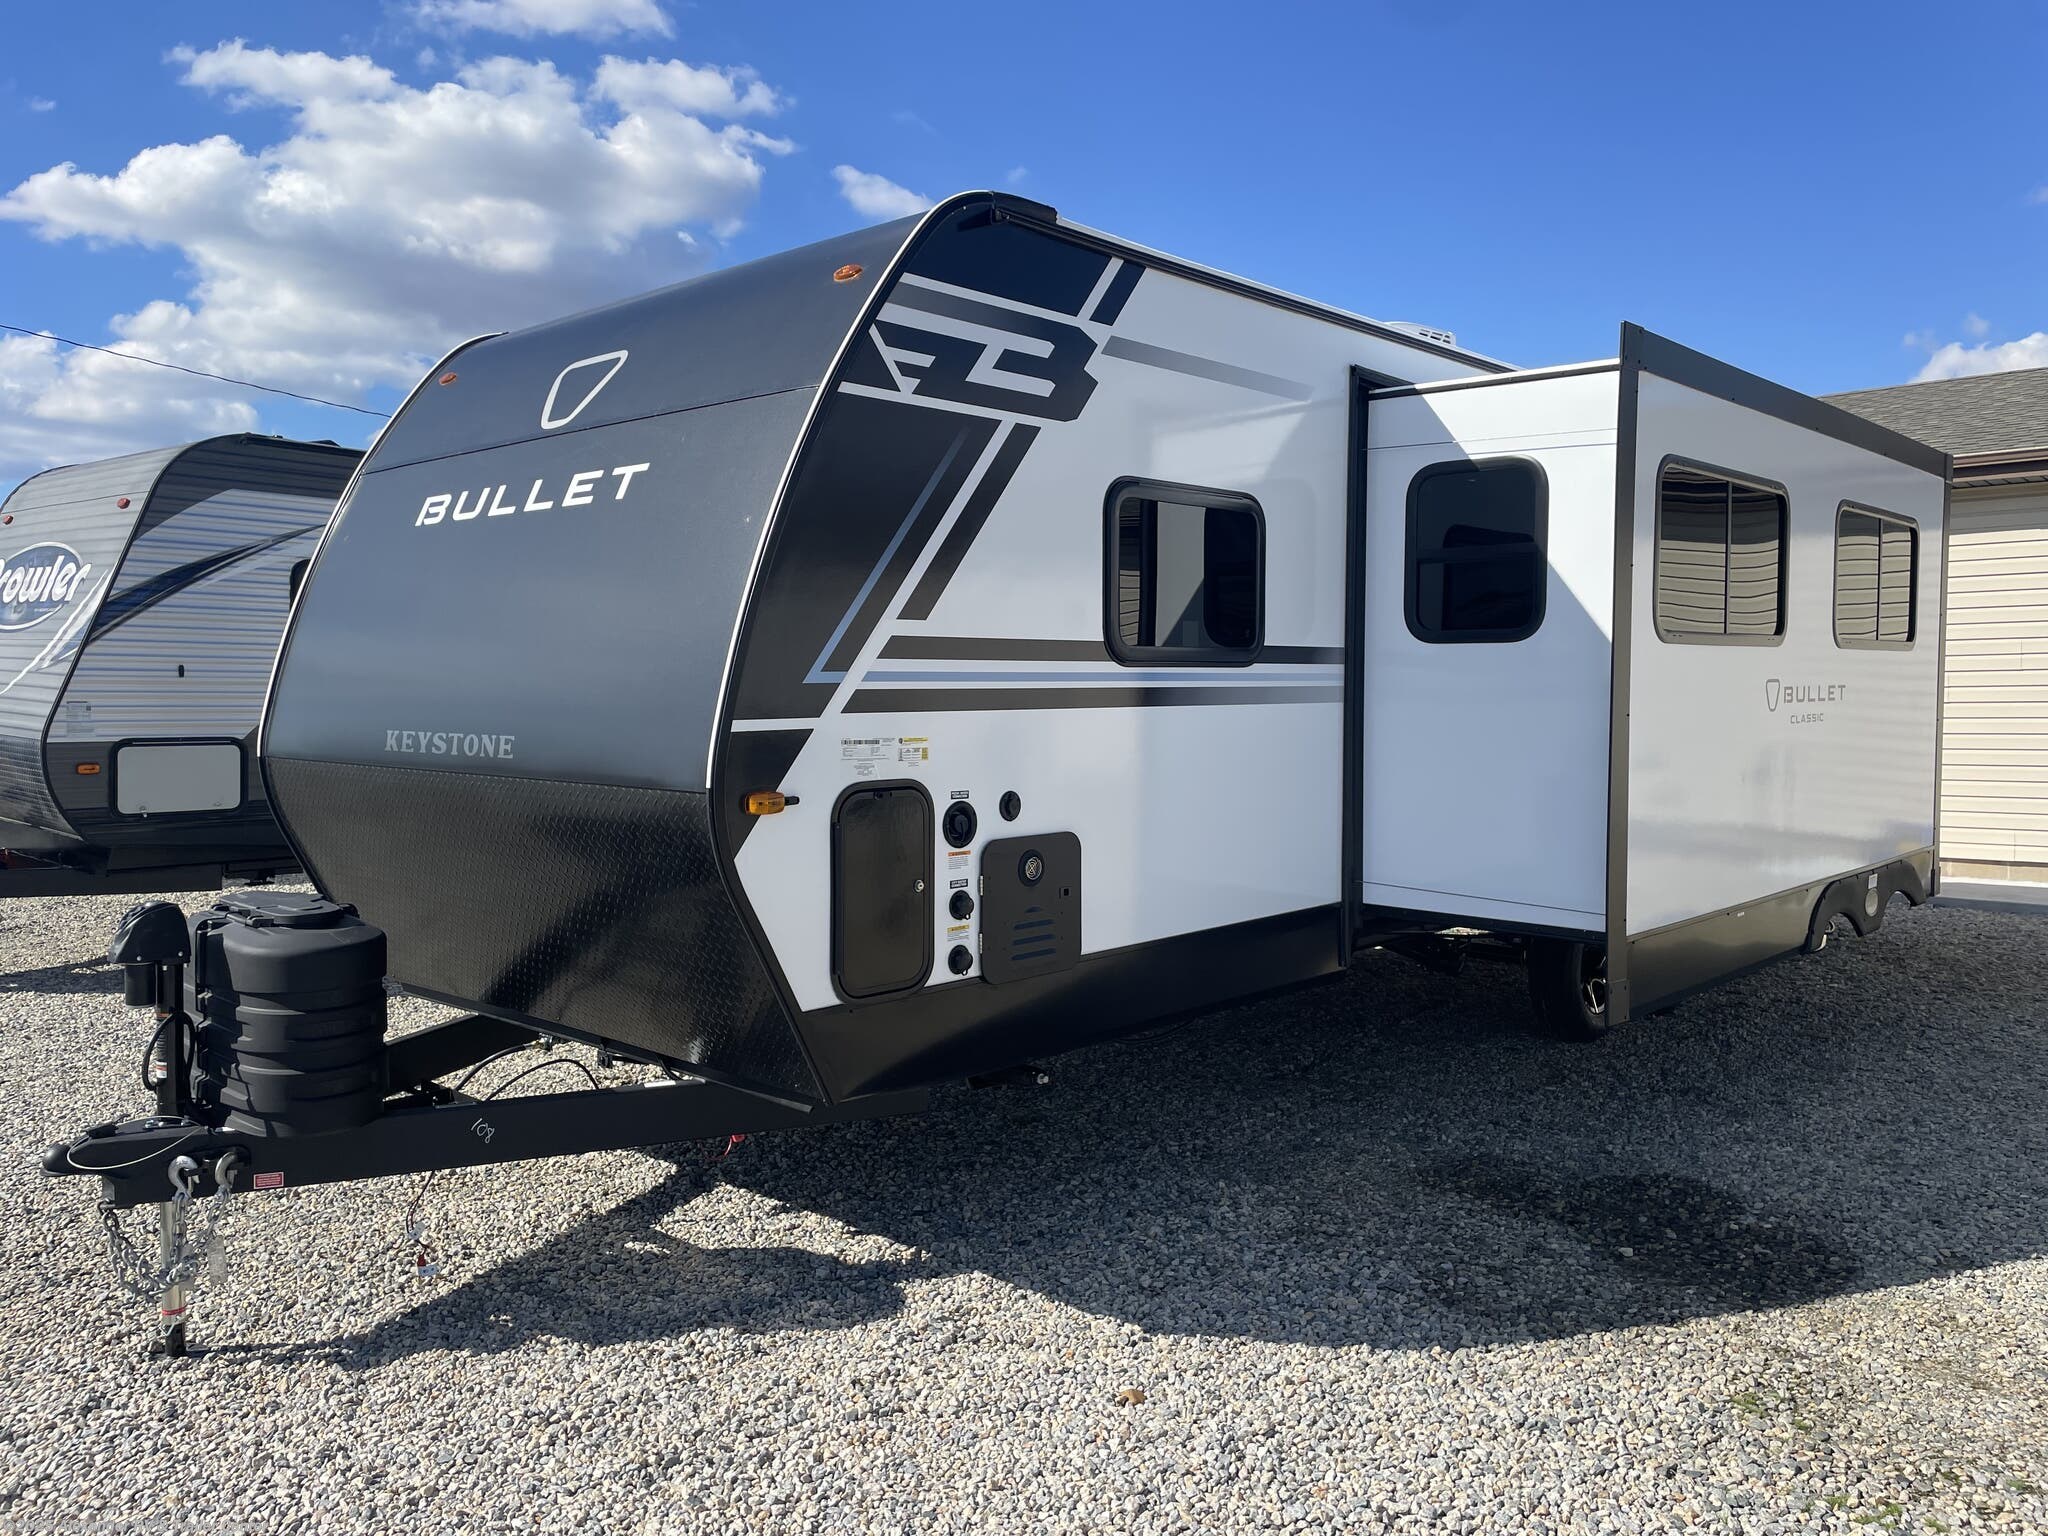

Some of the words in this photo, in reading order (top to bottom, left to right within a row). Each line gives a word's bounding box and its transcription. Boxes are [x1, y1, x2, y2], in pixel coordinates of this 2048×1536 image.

[415, 462, 651, 527] BULLET
[1783, 684, 1846, 704] BULLET
[1790, 713, 1824, 724] CLASSIC
[384, 729, 515, 759] KEYSTONE
